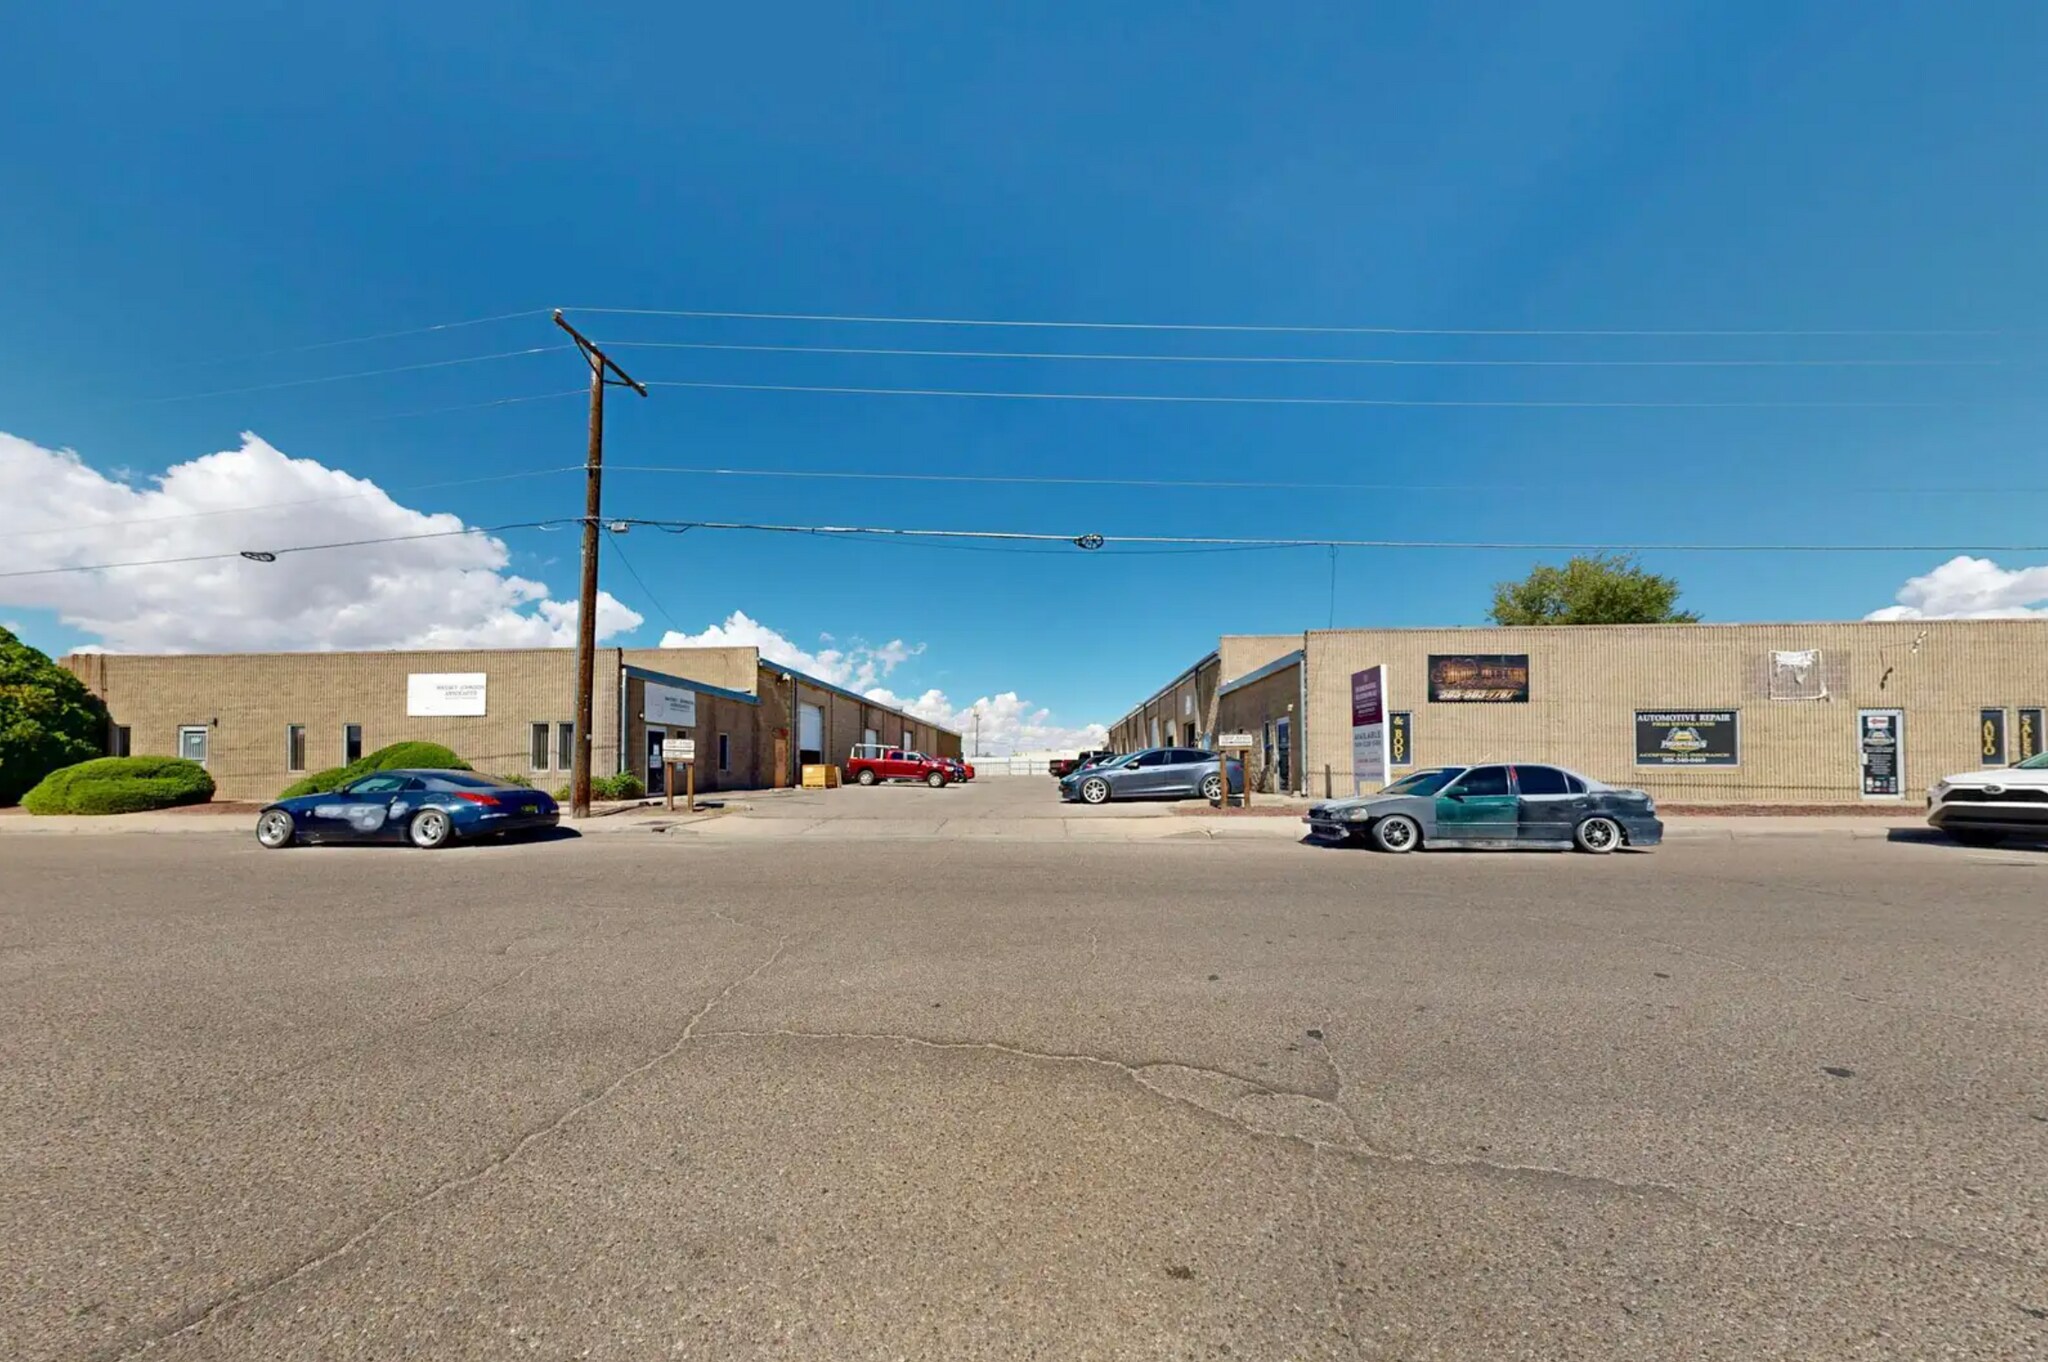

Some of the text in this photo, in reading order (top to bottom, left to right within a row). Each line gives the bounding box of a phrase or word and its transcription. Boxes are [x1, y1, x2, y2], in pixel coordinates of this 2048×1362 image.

[1637, 714, 1731, 722] AUTOMOTIVE REPAIR
[1393, 716, 1404, 762] & BODY
[1983, 720, 1996, 756] AUTO
